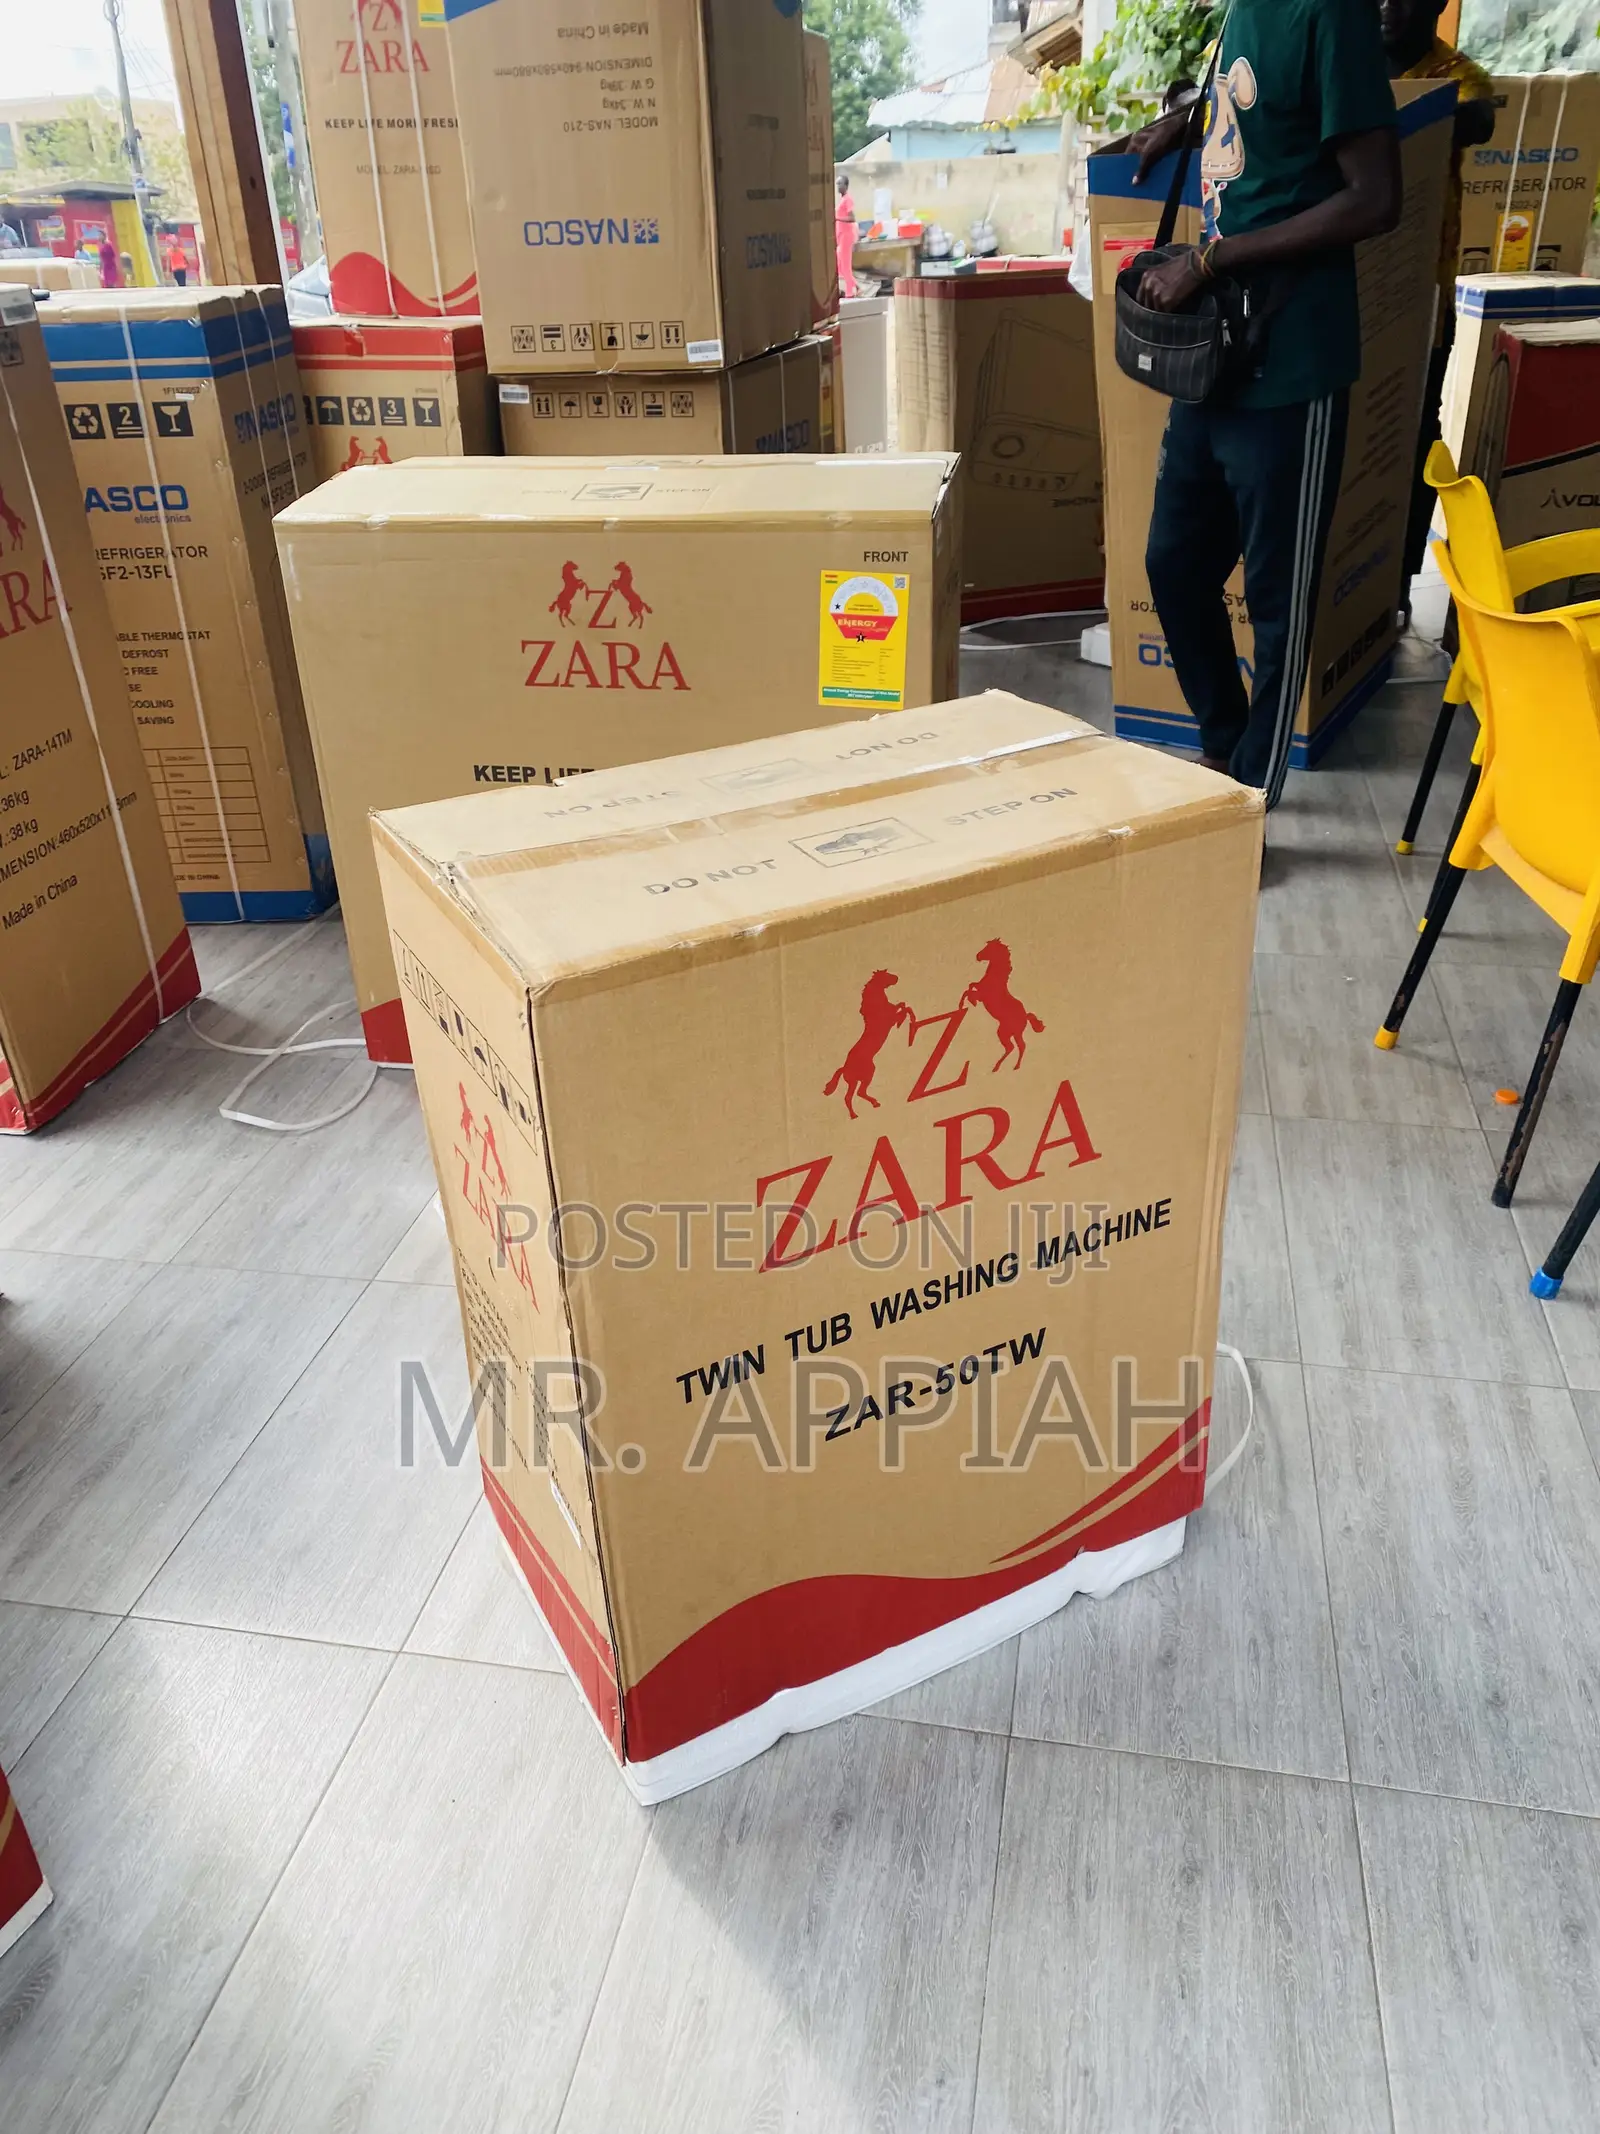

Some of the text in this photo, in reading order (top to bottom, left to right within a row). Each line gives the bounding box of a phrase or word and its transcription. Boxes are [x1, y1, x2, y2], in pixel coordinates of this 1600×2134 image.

[557, 22, 649, 39] Made in China
[336, 39, 431, 74] ZARA
[325, 118, 355, 129] KEEP
[563, 119, 612, 133] NAS-210
[523, 218, 630, 247] NASCO
[118, 405, 133, 425] 2
[386, 399, 398, 416] 3
[863, 551, 909, 563] FRONT
[0, 558, 73, 639] RA
[837, 618, 878, 628] ENERGY
[122, 649, 169, 659] DEFROST
[521, 639, 692, 691] ZARA
[131, 666, 159, 676] FREE
[137, 716, 175, 725] SAVING
[12, 728, 73, 771] ZARA-14TM
[474, 764, 537, 784] KEEP
[643, 787, 1080, 896] DO NOT STEP ON
[2, 873, 78, 930] Made in China
[907, 1007, 971, 1103] Z
[756, 1079, 1102, 1274] ZARA
[453, 1142, 541, 1315] ZARA
[676, 1198, 1172, 1404] TWIN TUB WASHING MACHINE
[824, 1327, 1047, 1441] ZAR-50TW
